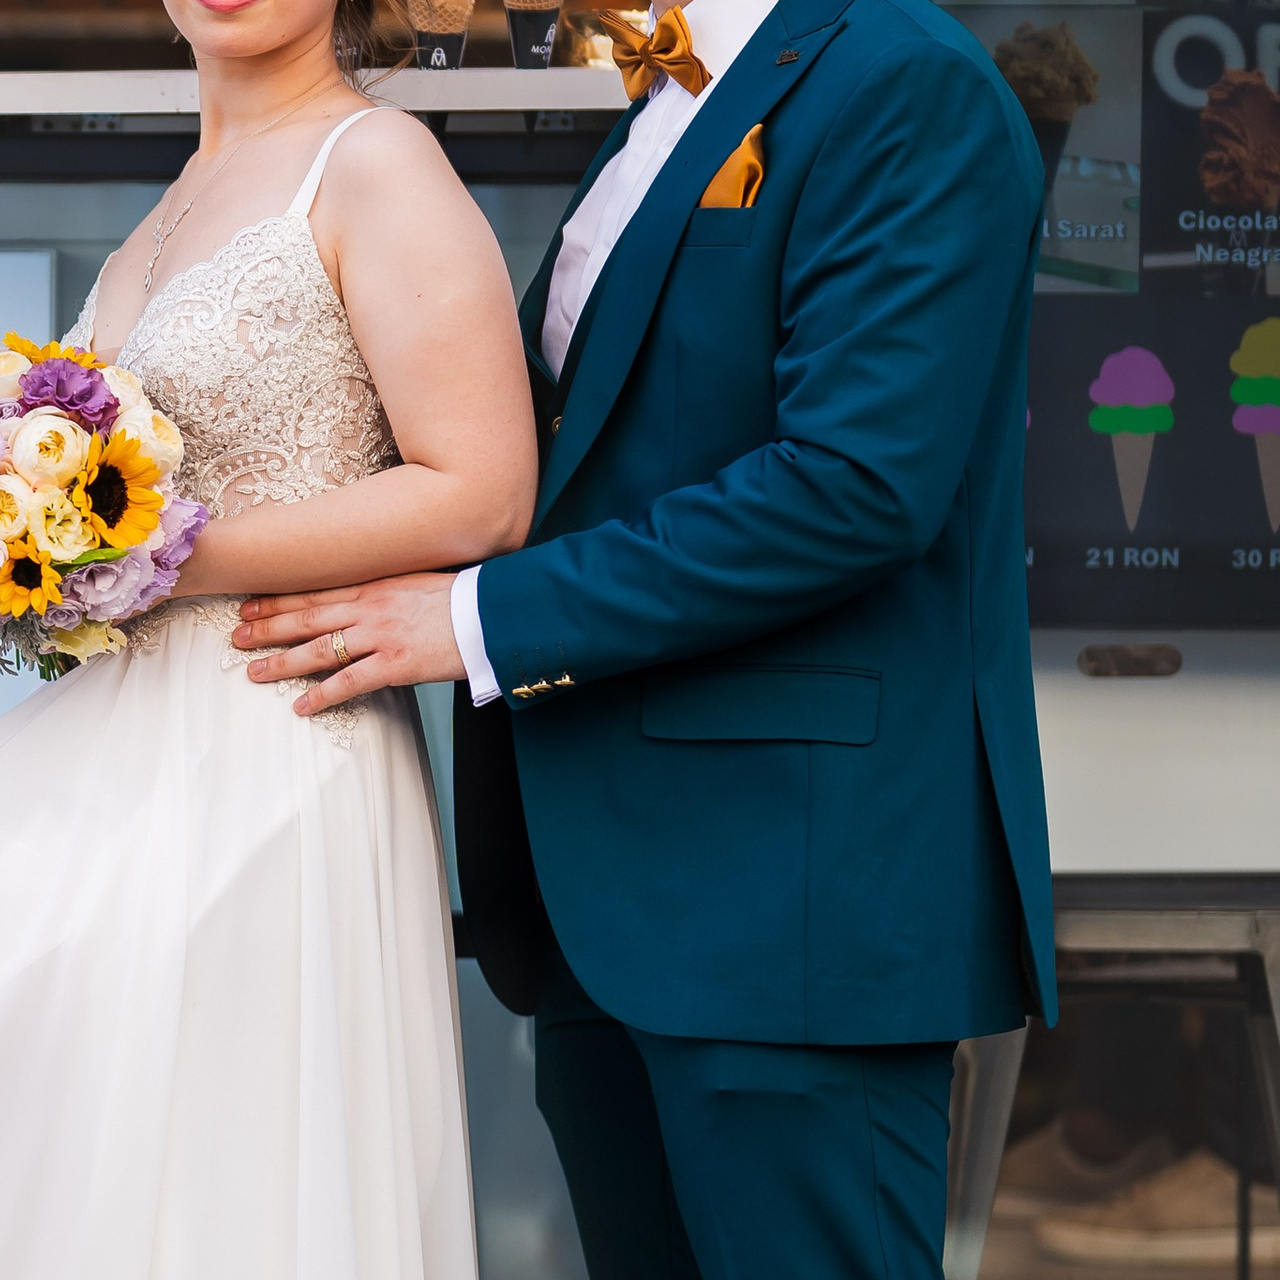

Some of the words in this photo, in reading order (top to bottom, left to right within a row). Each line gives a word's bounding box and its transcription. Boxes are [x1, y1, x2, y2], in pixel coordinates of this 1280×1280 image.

[1056, 218, 1126, 239] Sarat
[1179, 209, 1280, 231] Ciocola
[1085, 547, 1115, 568] 21
[1123, 547, 1180, 568] RON
[1231, 548, 1263, 569] 30
